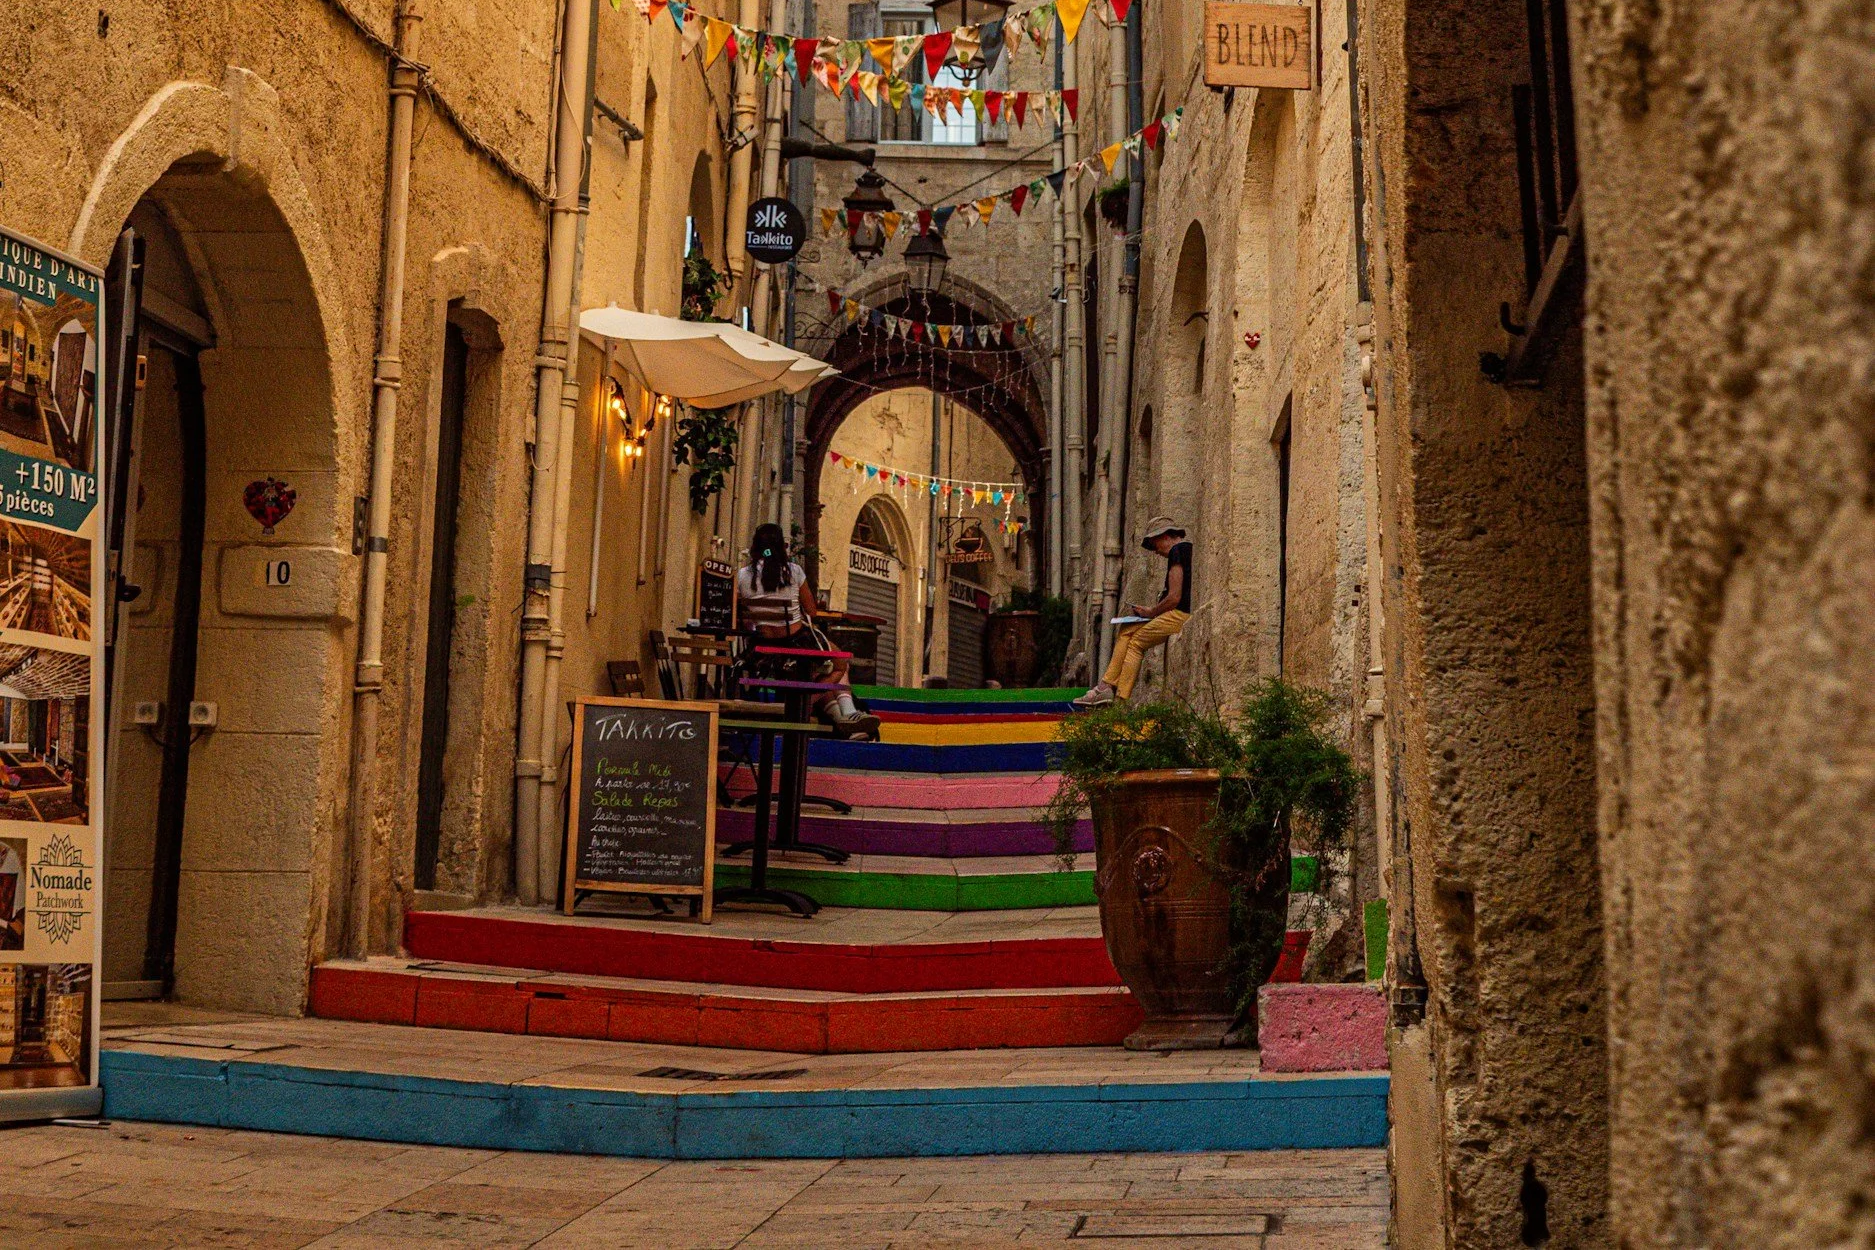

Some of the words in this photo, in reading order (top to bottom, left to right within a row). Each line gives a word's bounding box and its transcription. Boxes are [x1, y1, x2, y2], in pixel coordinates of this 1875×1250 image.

[1216, 23, 1298, 68] BLEND
[747, 231, 793, 245] Takkito
[50, 258, 97, 293] D'ART
[16, 462, 64, 497] +150
[6, 489, 55, 518] pièces
[266, 560, 291, 585] 10
[705, 560, 733, 575] OPEN
[592, 790, 634, 807] Salade
[643, 792, 679, 812] Repas
[30, 866, 92, 891] Nomade
[36, 891, 84, 909] Patchwork
